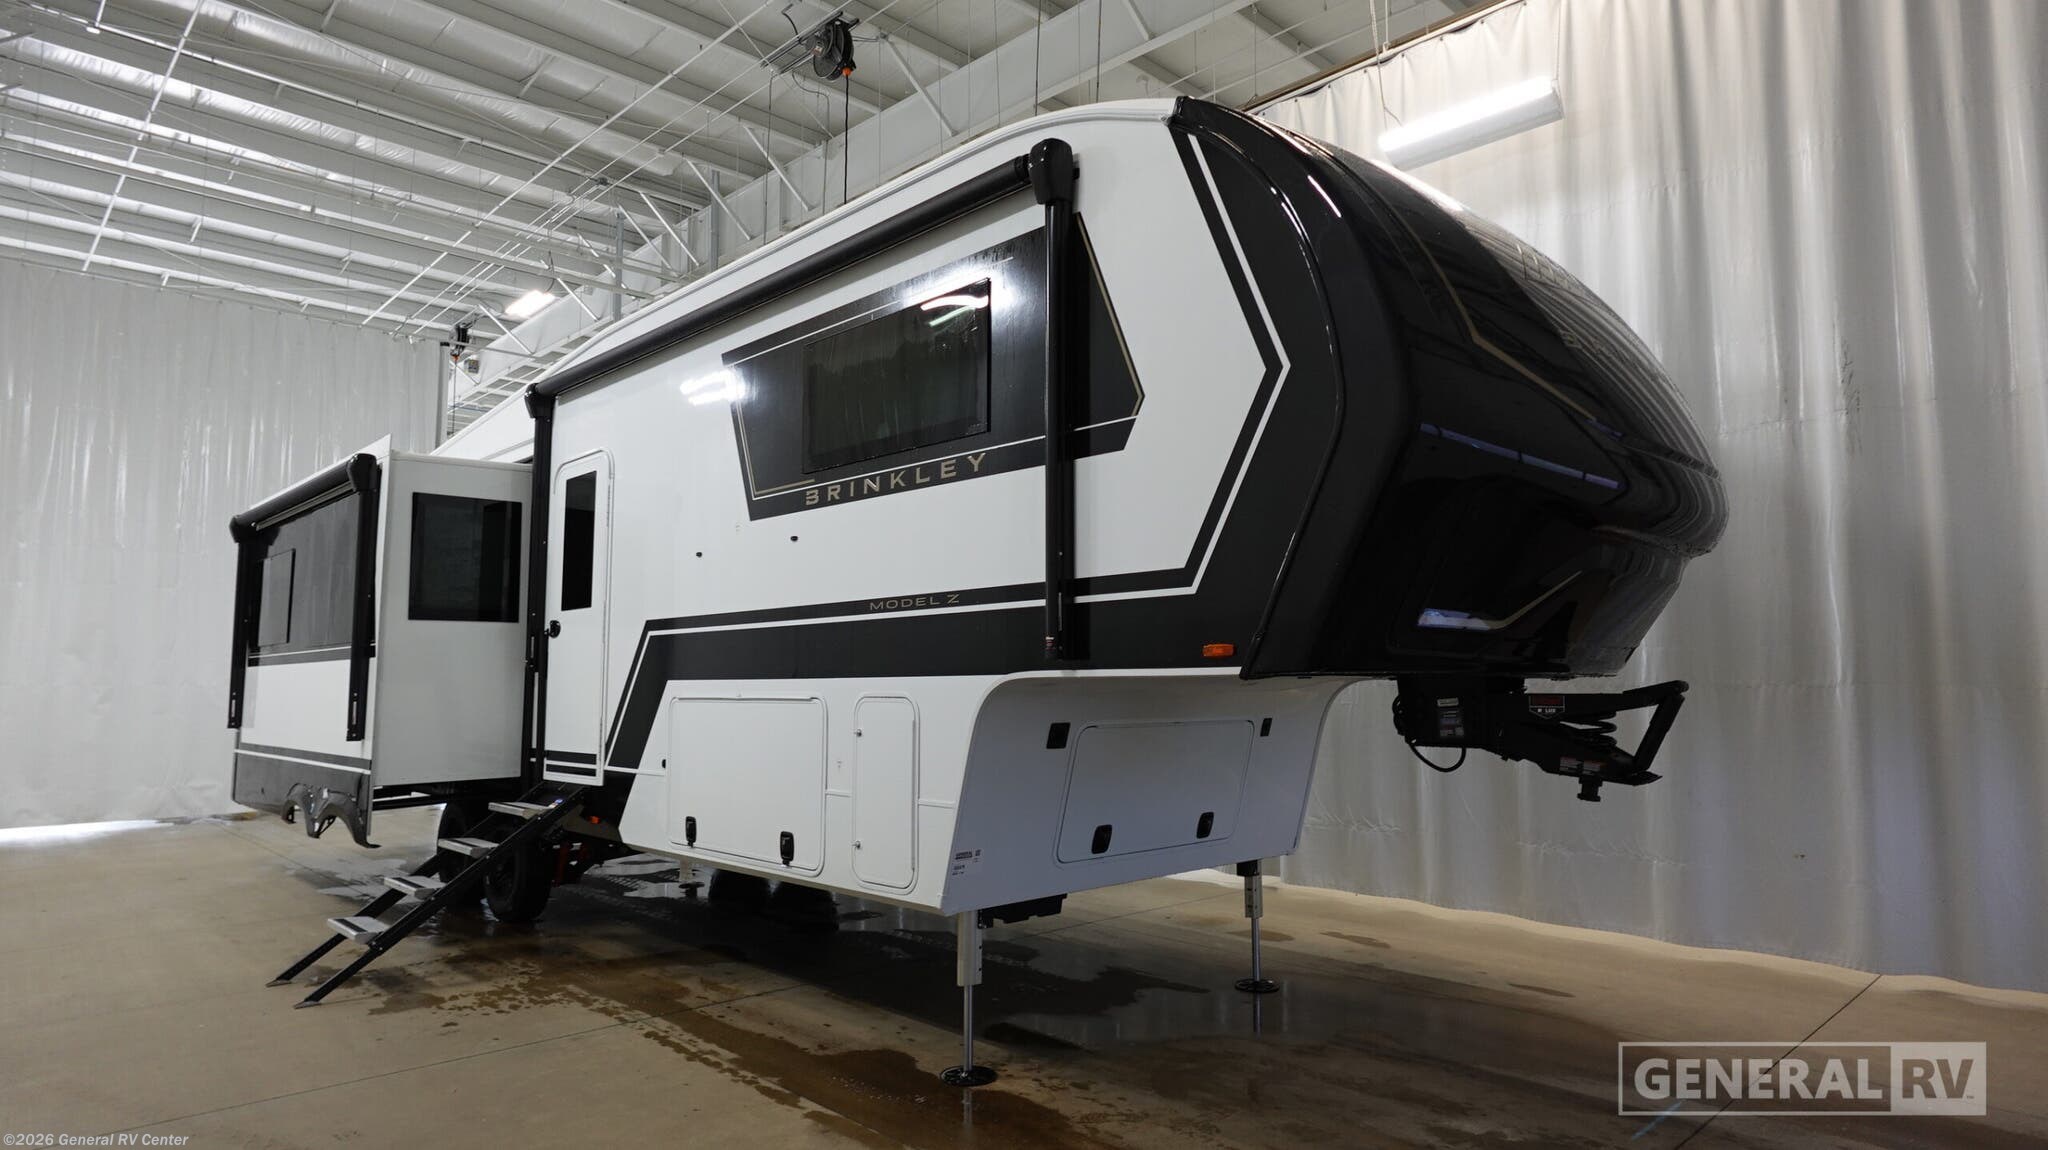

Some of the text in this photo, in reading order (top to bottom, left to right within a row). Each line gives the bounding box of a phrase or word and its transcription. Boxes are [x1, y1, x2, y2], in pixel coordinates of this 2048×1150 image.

[805, 452, 987, 506] BRINKLEY
[869, 593, 960, 611] MODEL Z
